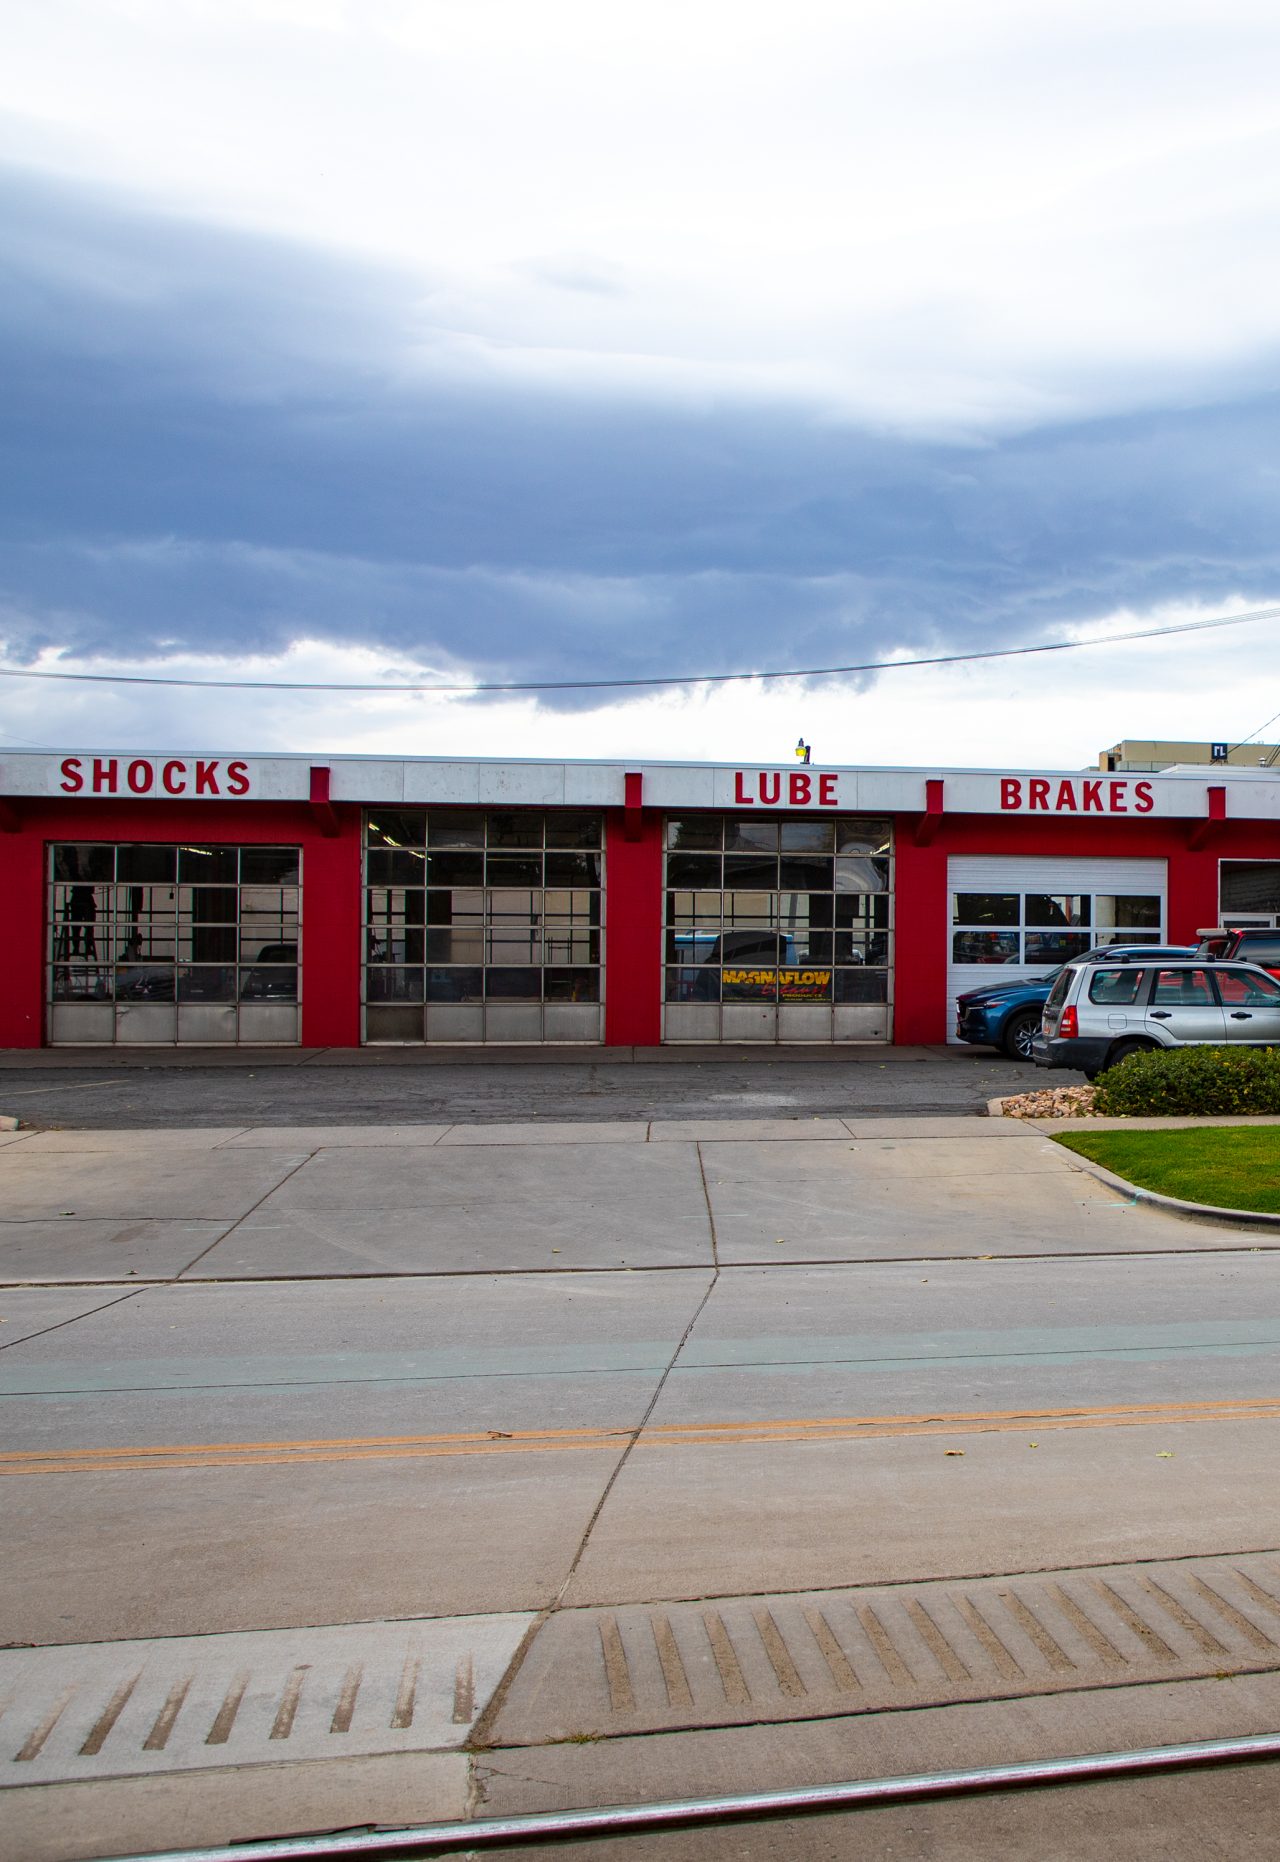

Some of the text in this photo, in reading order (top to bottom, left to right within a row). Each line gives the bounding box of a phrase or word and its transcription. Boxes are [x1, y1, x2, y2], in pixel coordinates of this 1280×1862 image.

[61, 758, 250, 796] SHOCKS
[735, 771, 838, 806] LUBE
[1000, 778, 1154, 814] BRAKES
[722, 969, 831, 985] MAGNAFLOW
